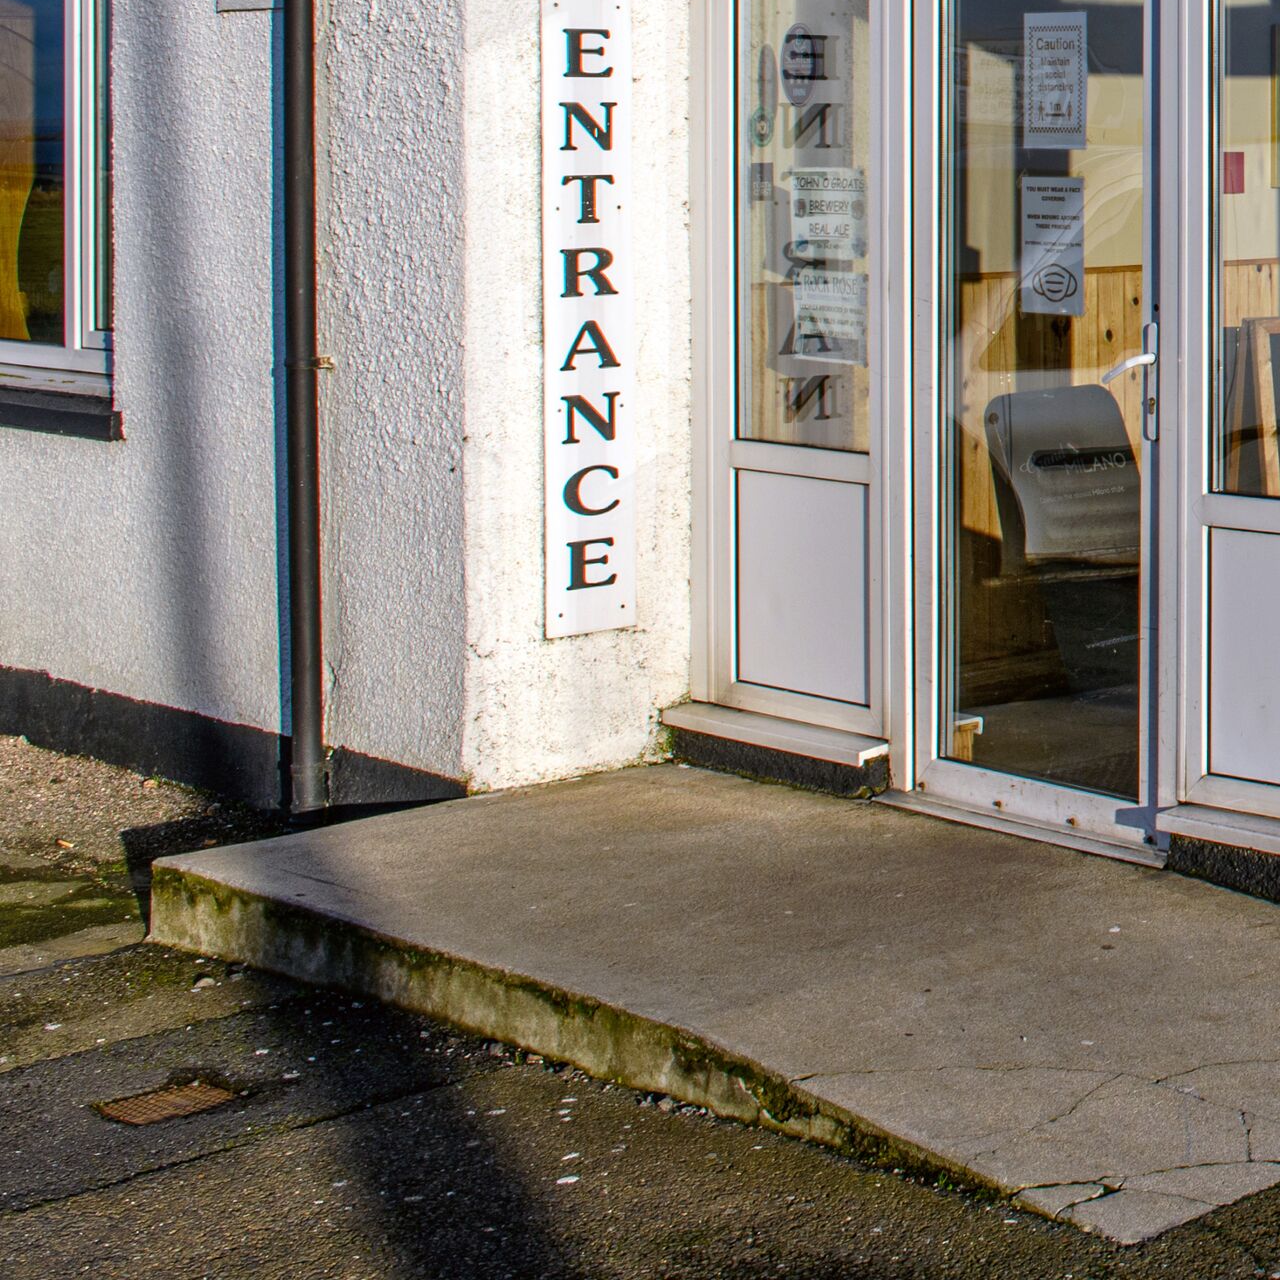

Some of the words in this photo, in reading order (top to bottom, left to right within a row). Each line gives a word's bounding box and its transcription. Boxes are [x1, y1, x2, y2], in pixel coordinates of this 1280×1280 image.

[1036, 38, 1075, 50] Caution
[1041, 57, 1071, 66] Maintain
[794, 176, 820, 188] JOHN
[808, 199, 850, 212] BREWERY
[808, 222, 831, 235] REAL
[834, 223, 850, 237] ALE
[558, 28, 621, 592] ENTRANCE
[1064, 452, 1127, 475] MILANO
